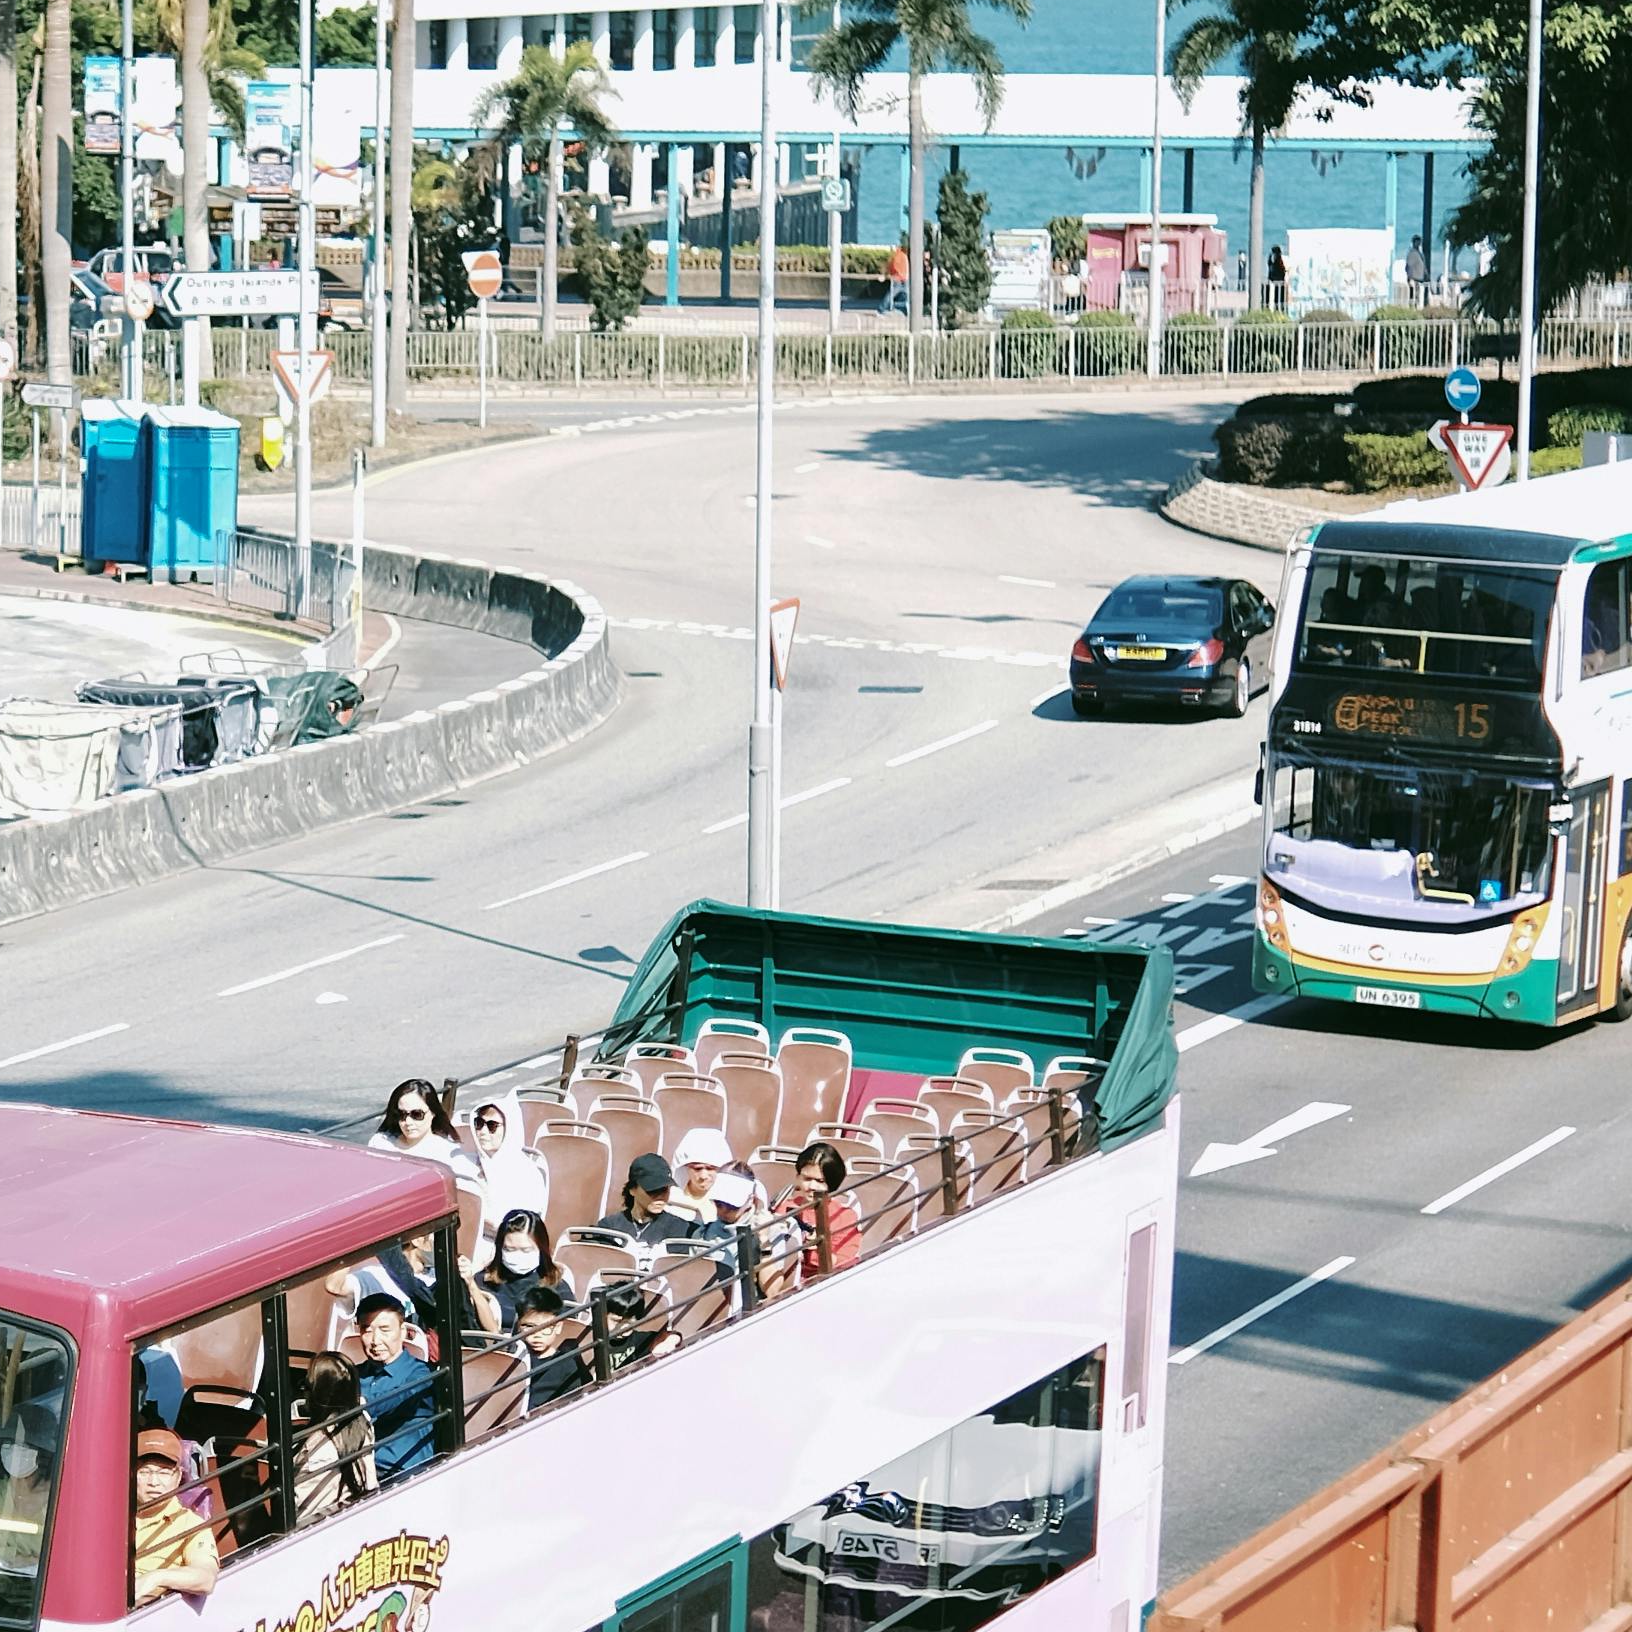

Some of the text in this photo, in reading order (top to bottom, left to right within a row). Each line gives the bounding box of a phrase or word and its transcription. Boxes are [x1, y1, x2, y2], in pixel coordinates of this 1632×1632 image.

[1463, 433, 1487, 442] GIVE
[1464, 444, 1487, 453] WAY
[1455, 702, 1489, 739] 15
[1359, 989, 1416, 1006] UN 6395
